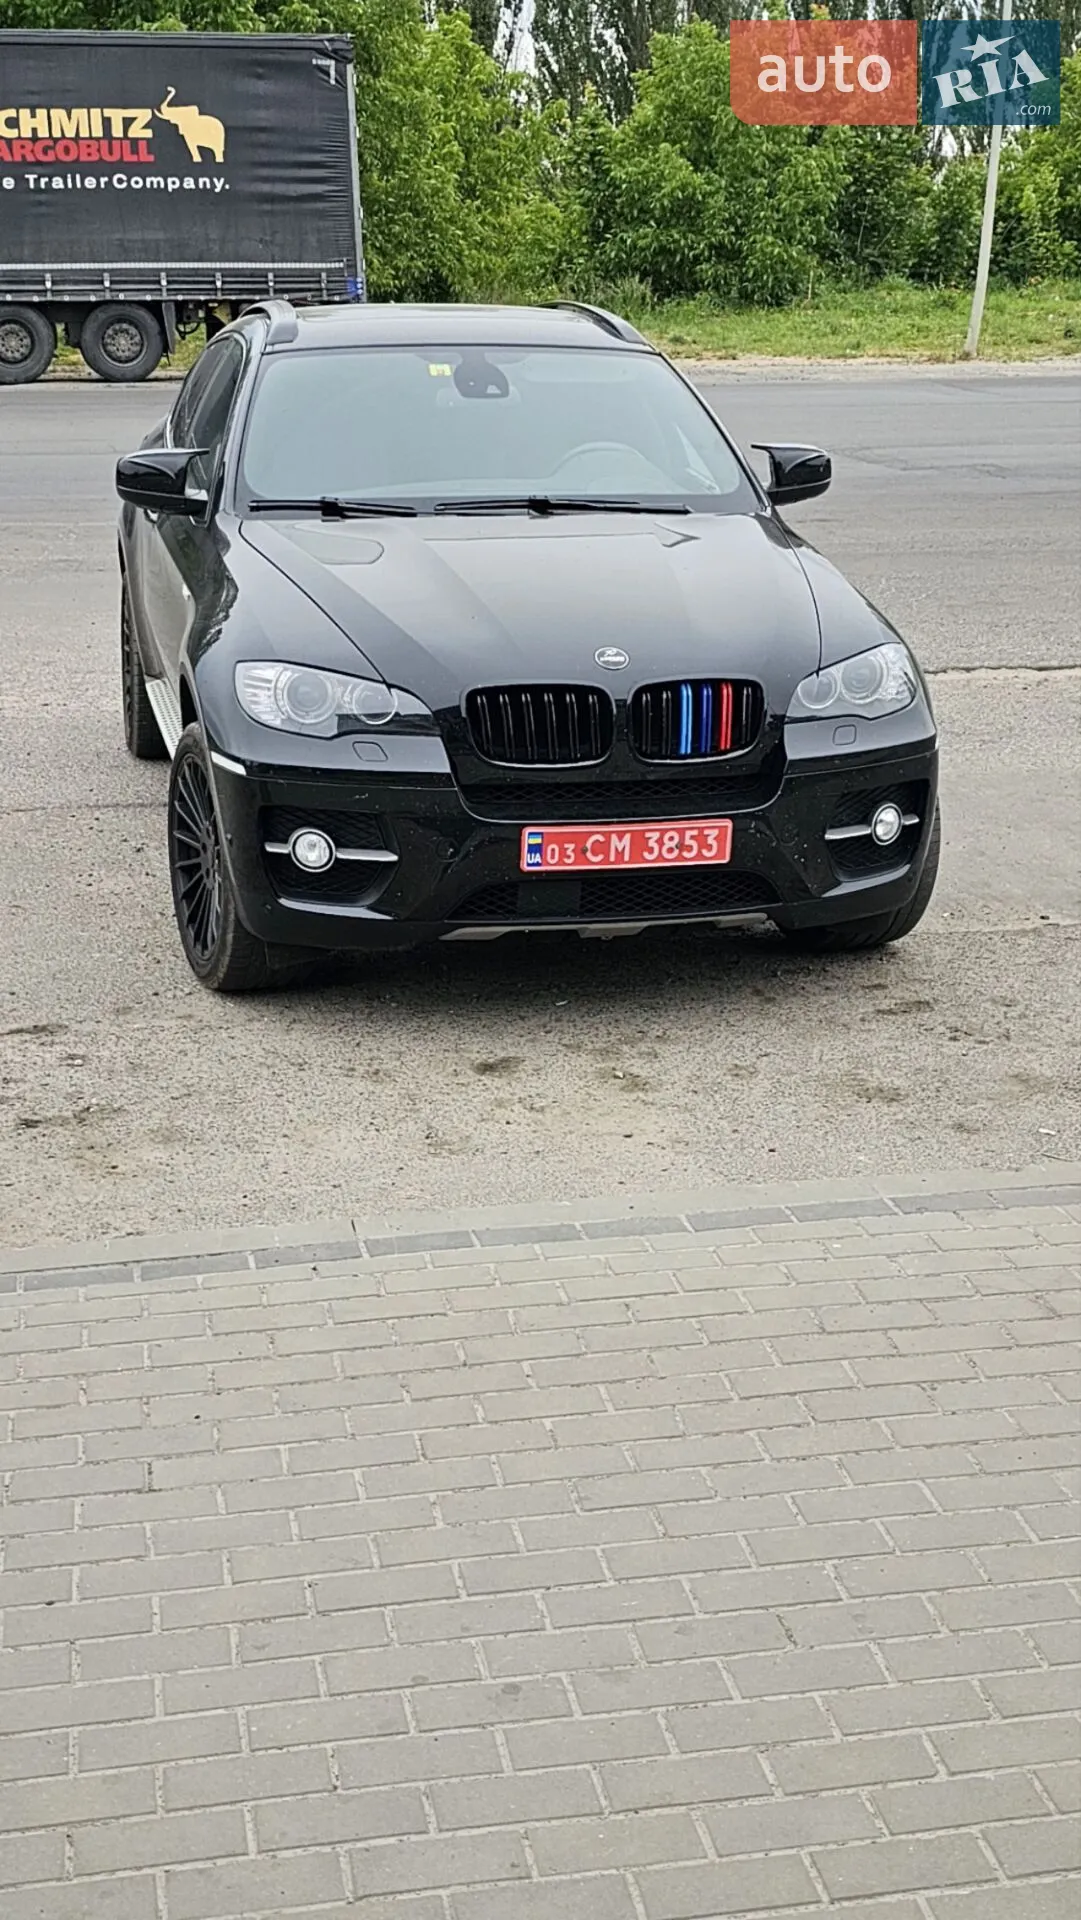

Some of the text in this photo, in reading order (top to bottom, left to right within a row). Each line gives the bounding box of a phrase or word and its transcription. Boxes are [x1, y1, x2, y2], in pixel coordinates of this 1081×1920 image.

[0, 107, 153, 138] CHMITZ
[527, 852, 542, 864] UA
[546, 829, 720, 864] 03 CM 3853
